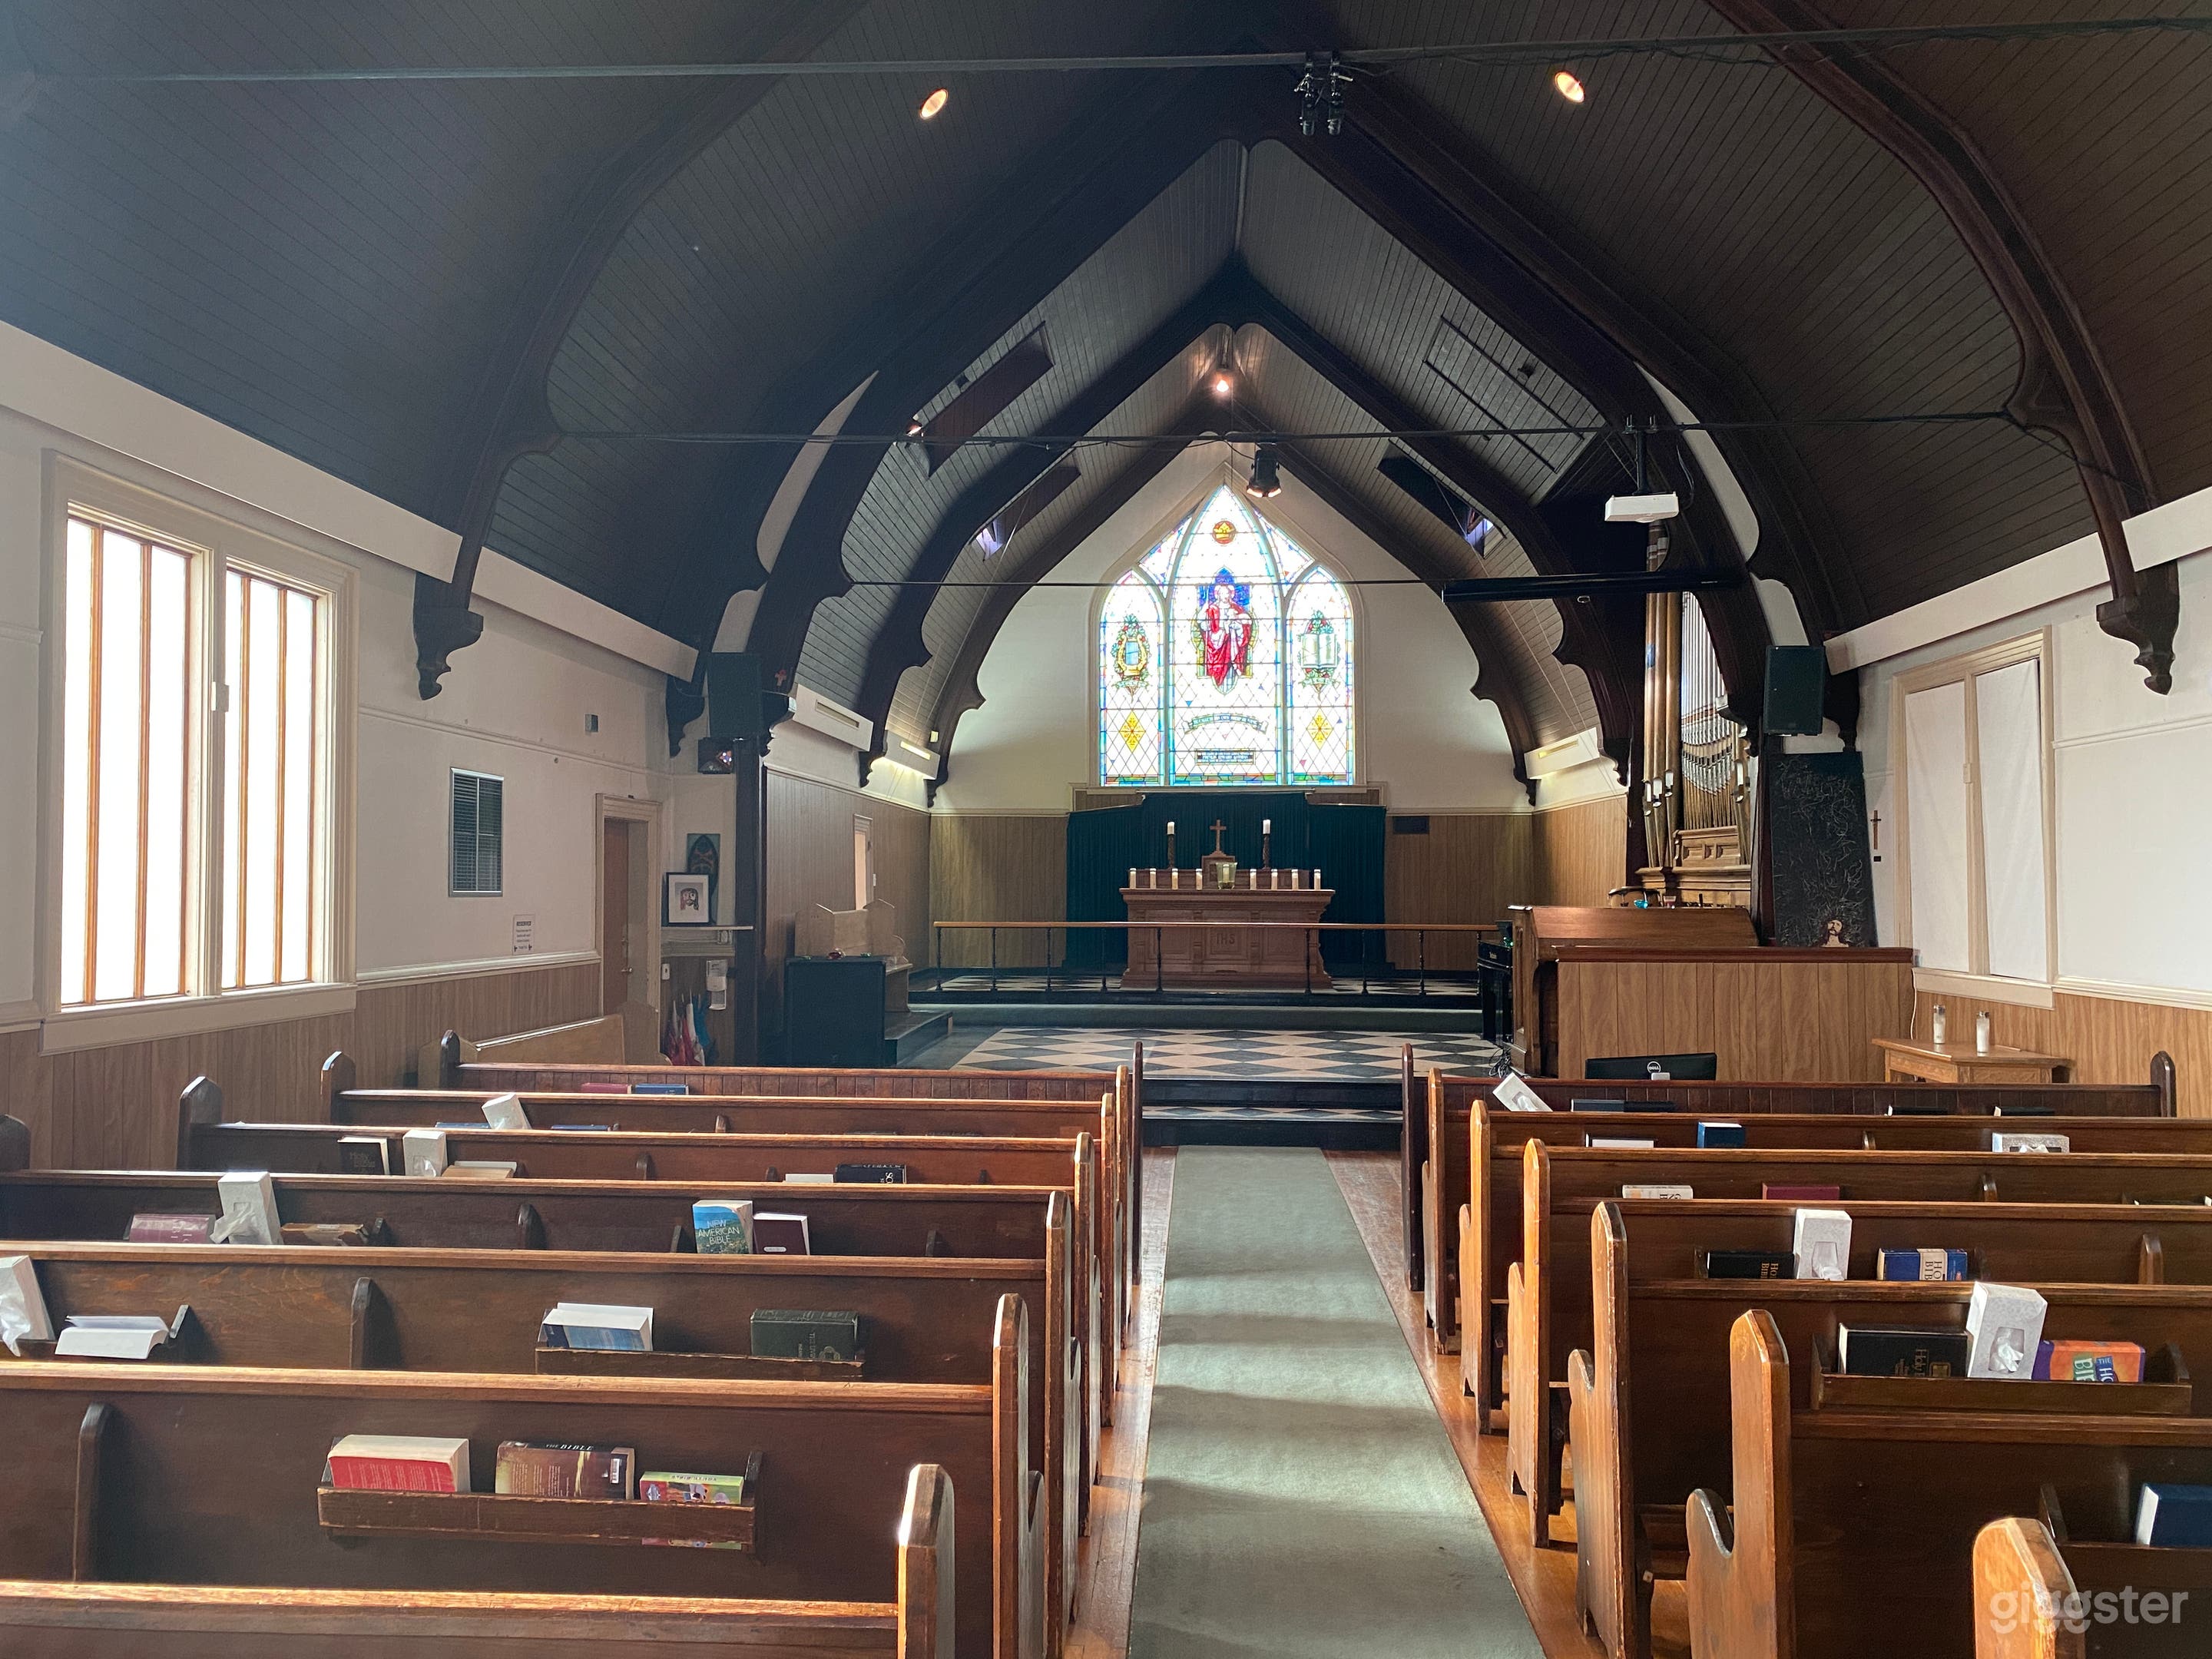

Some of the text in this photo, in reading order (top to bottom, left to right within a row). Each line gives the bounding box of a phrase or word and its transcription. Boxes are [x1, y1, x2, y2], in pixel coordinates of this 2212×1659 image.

[707, 1219, 727, 1228] NEW
[697, 1227, 740, 1237] AMERICAN
[709, 1235, 730, 1245] BIBLE
[1760, 1263, 1770, 1279] BIB
[1770, 1263, 1779, 1279] HO
[1925, 1261, 1933, 1280] BIB
[1933, 1261, 1942, 1280] HO
[2099, 1367, 2114, 1382] HO
